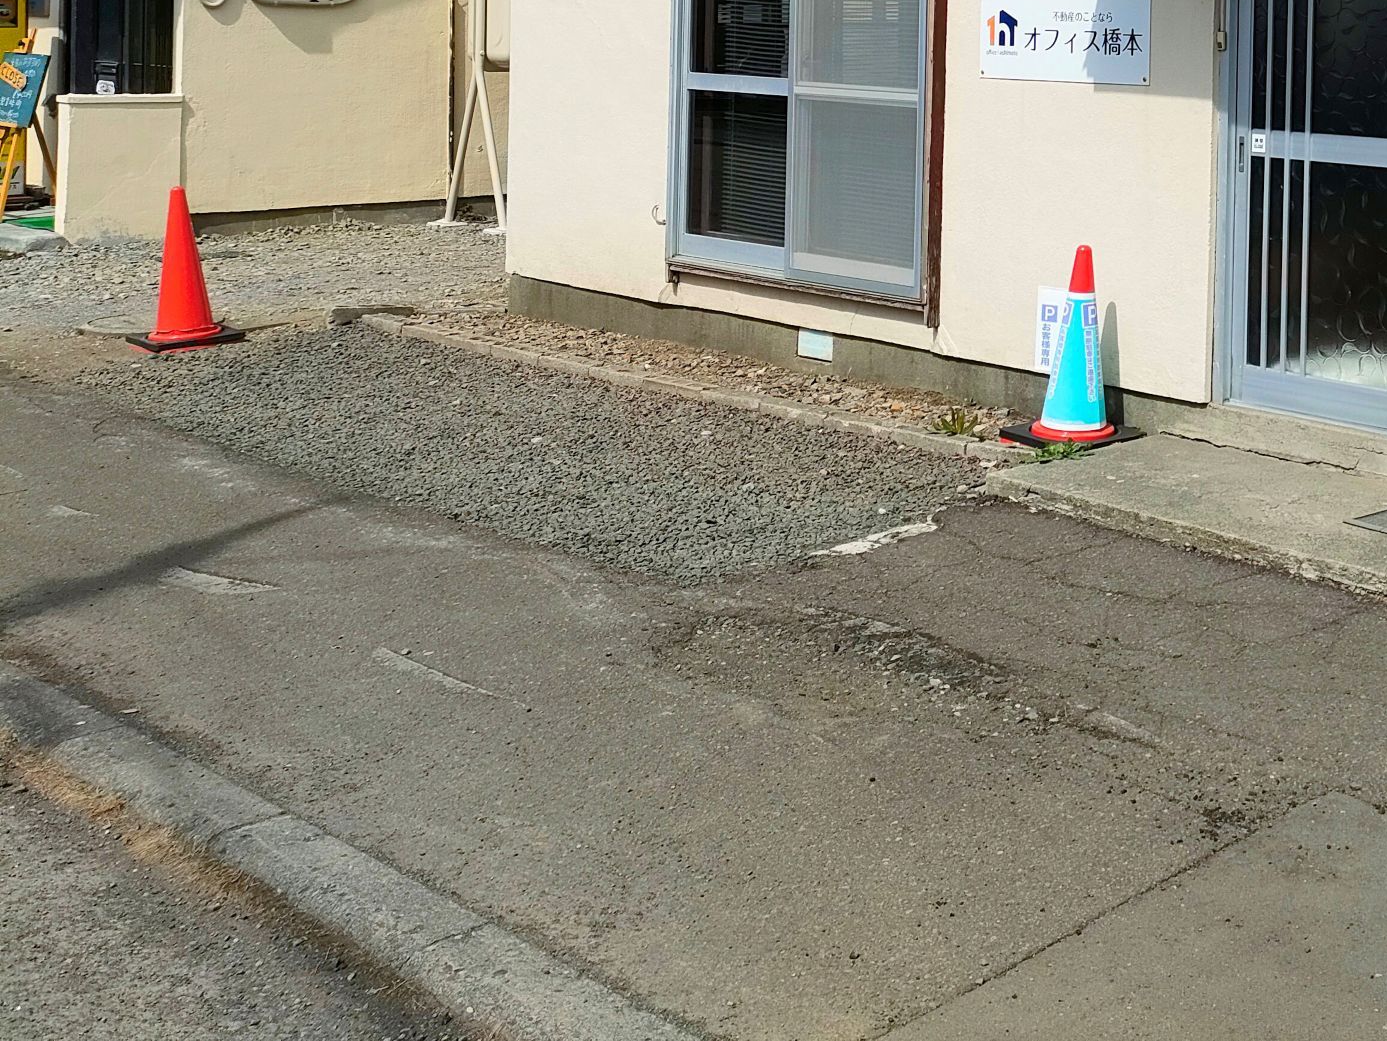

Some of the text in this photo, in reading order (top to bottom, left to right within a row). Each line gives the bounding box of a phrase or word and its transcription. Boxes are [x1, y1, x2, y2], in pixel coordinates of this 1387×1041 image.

[1052, 11, 1113, 23] 不動産のことなら
[1023, 27, 1143, 56] オフィス橋本
[1044, 306, 1056, 320] P
